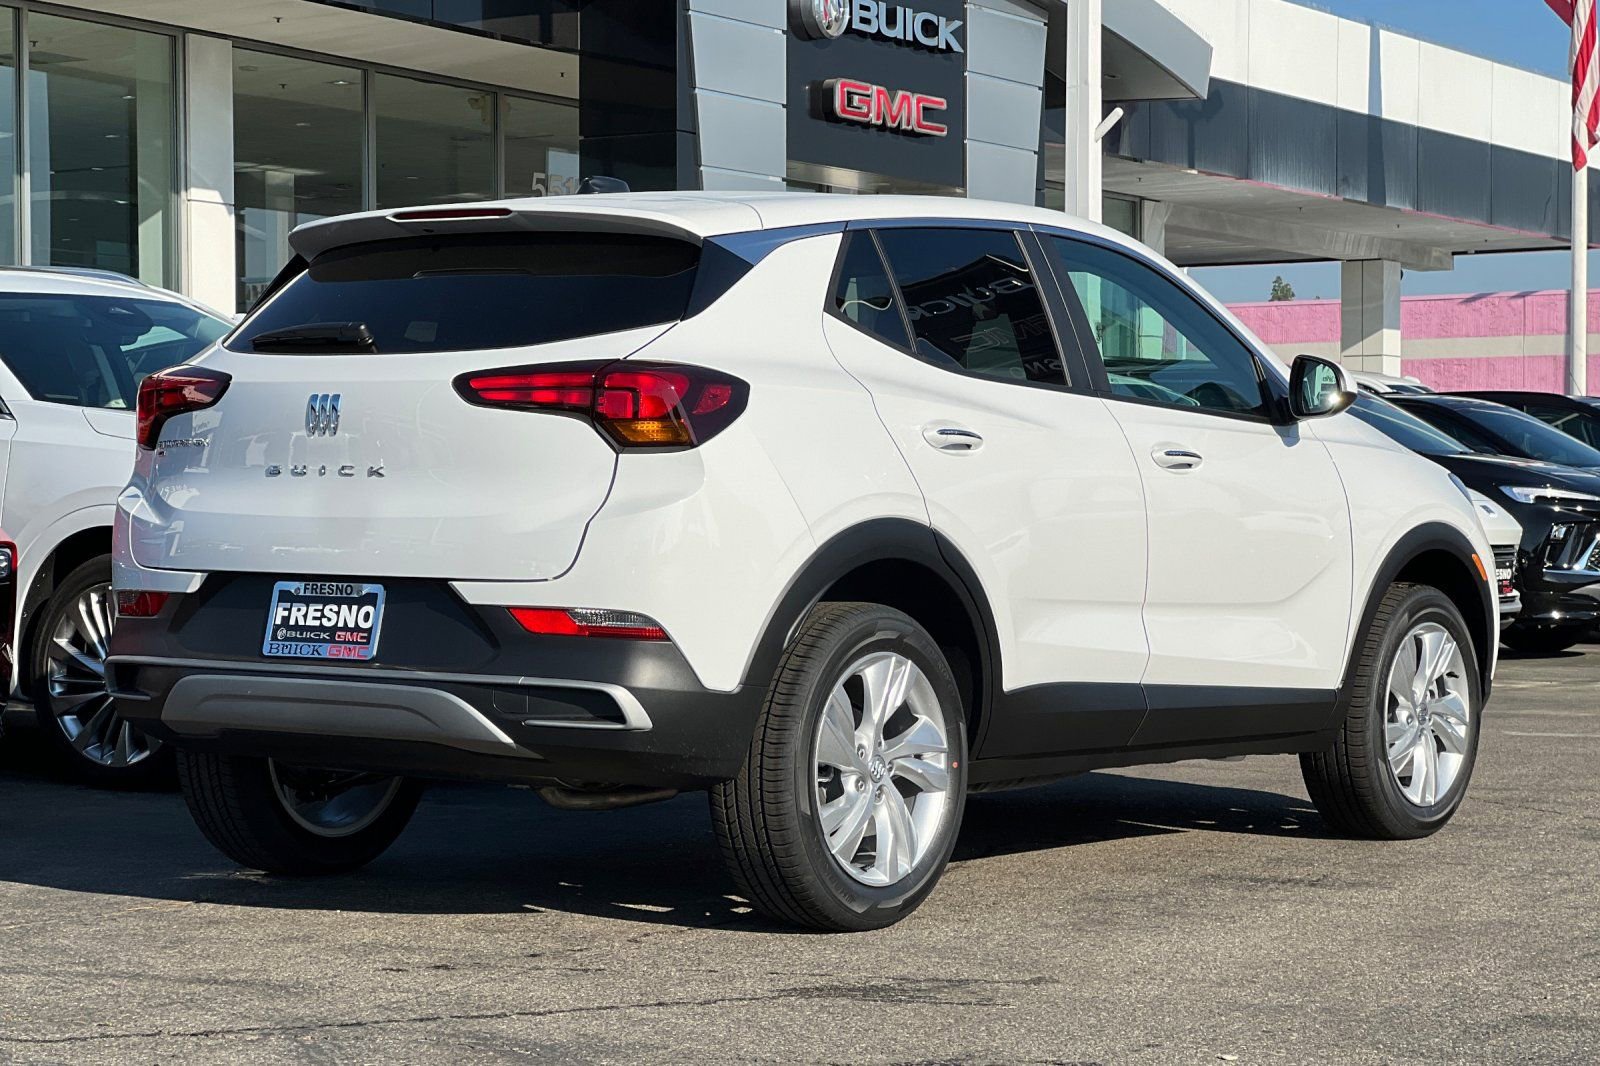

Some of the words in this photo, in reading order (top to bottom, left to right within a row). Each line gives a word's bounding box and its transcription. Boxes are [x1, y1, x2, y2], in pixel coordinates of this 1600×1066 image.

[852, 0, 964, 53] BUICK
[835, 78, 947, 137] GMC
[265, 465, 386, 478] BUICK
[303, 583, 354, 596] FRESNO
[275, 603, 375, 628] FRESNO
[286, 631, 331, 640] BUICK
[335, 631, 368, 642] GMC
[269, 643, 322, 656] BUICK
[327, 645, 369, 658] GMC
